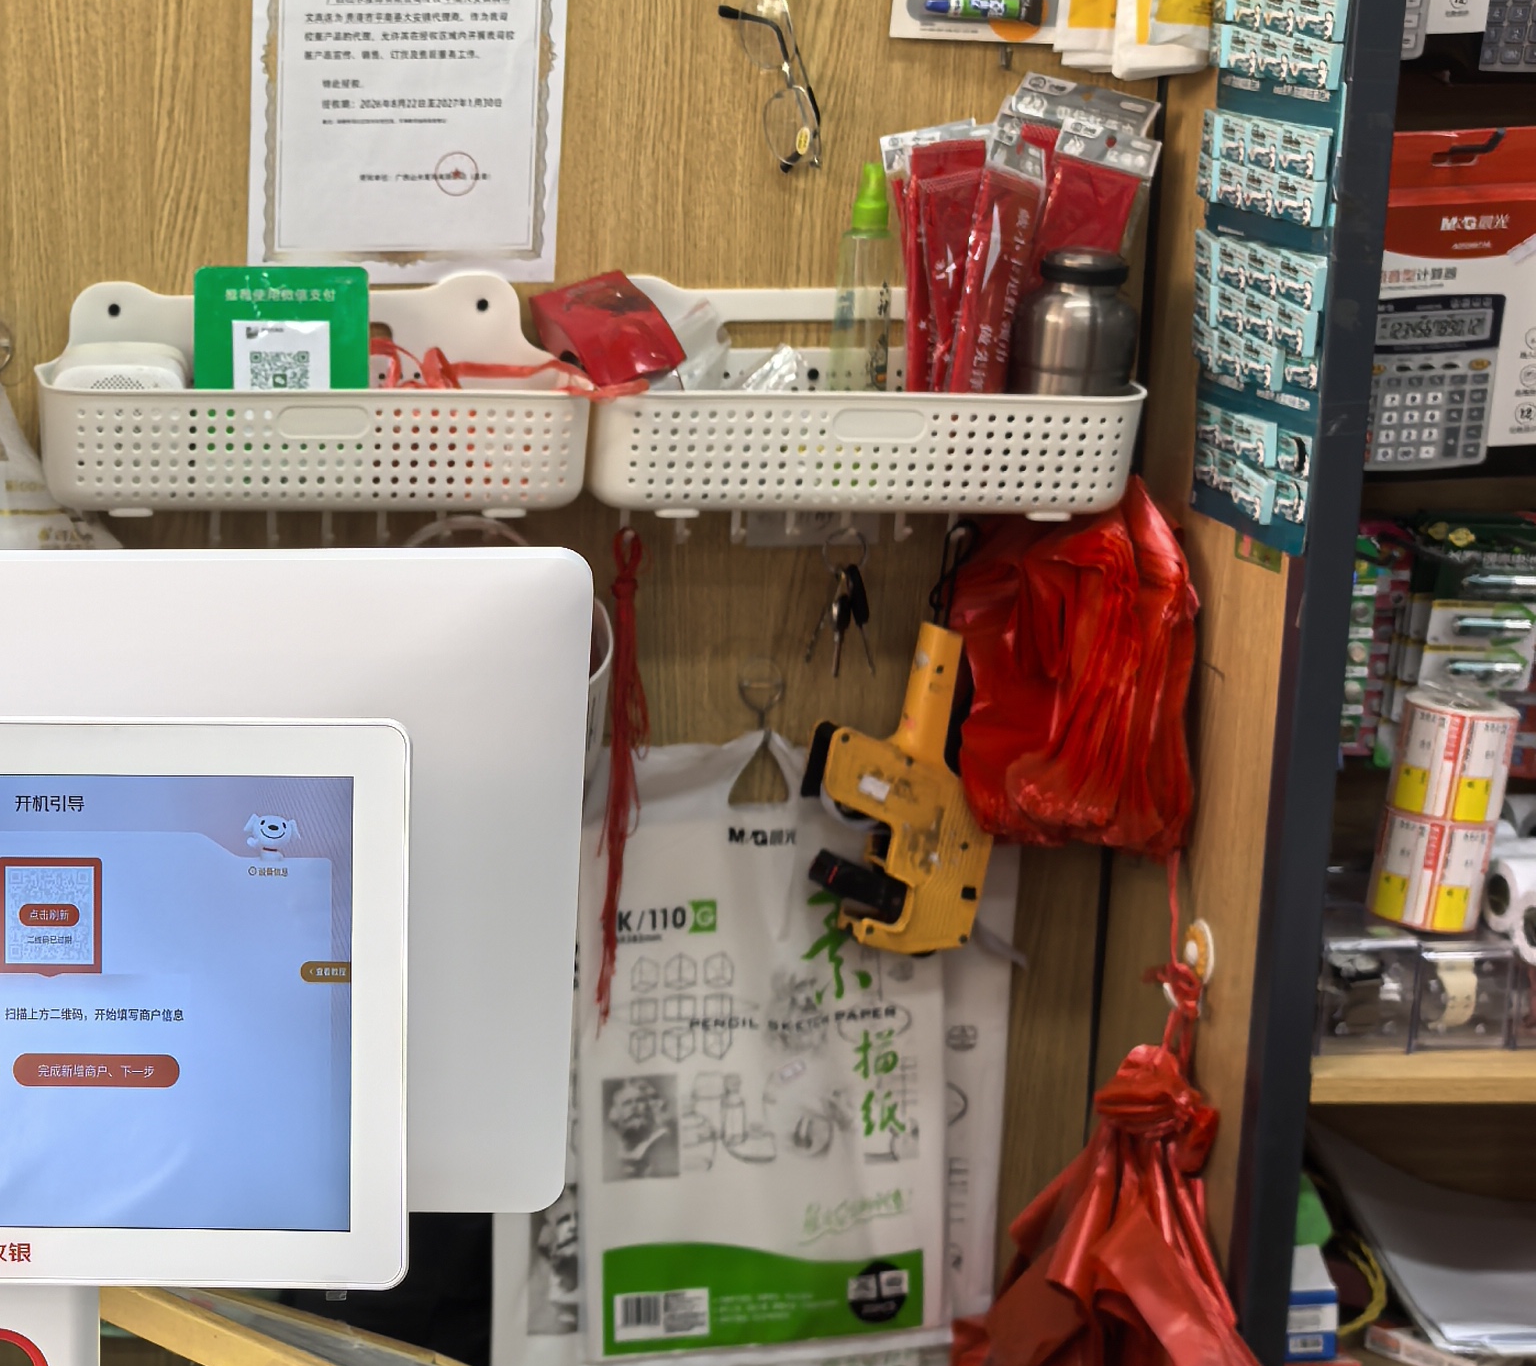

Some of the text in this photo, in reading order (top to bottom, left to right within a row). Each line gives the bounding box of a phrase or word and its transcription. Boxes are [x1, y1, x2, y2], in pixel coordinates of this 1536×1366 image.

[14, 794, 86, 814] 开机引导
[28, 908, 71, 922] 点击刷新
[834, 1005, 897, 1023] PAPER
[37, 1063, 156, 1079] 完成新增商户、下一步
